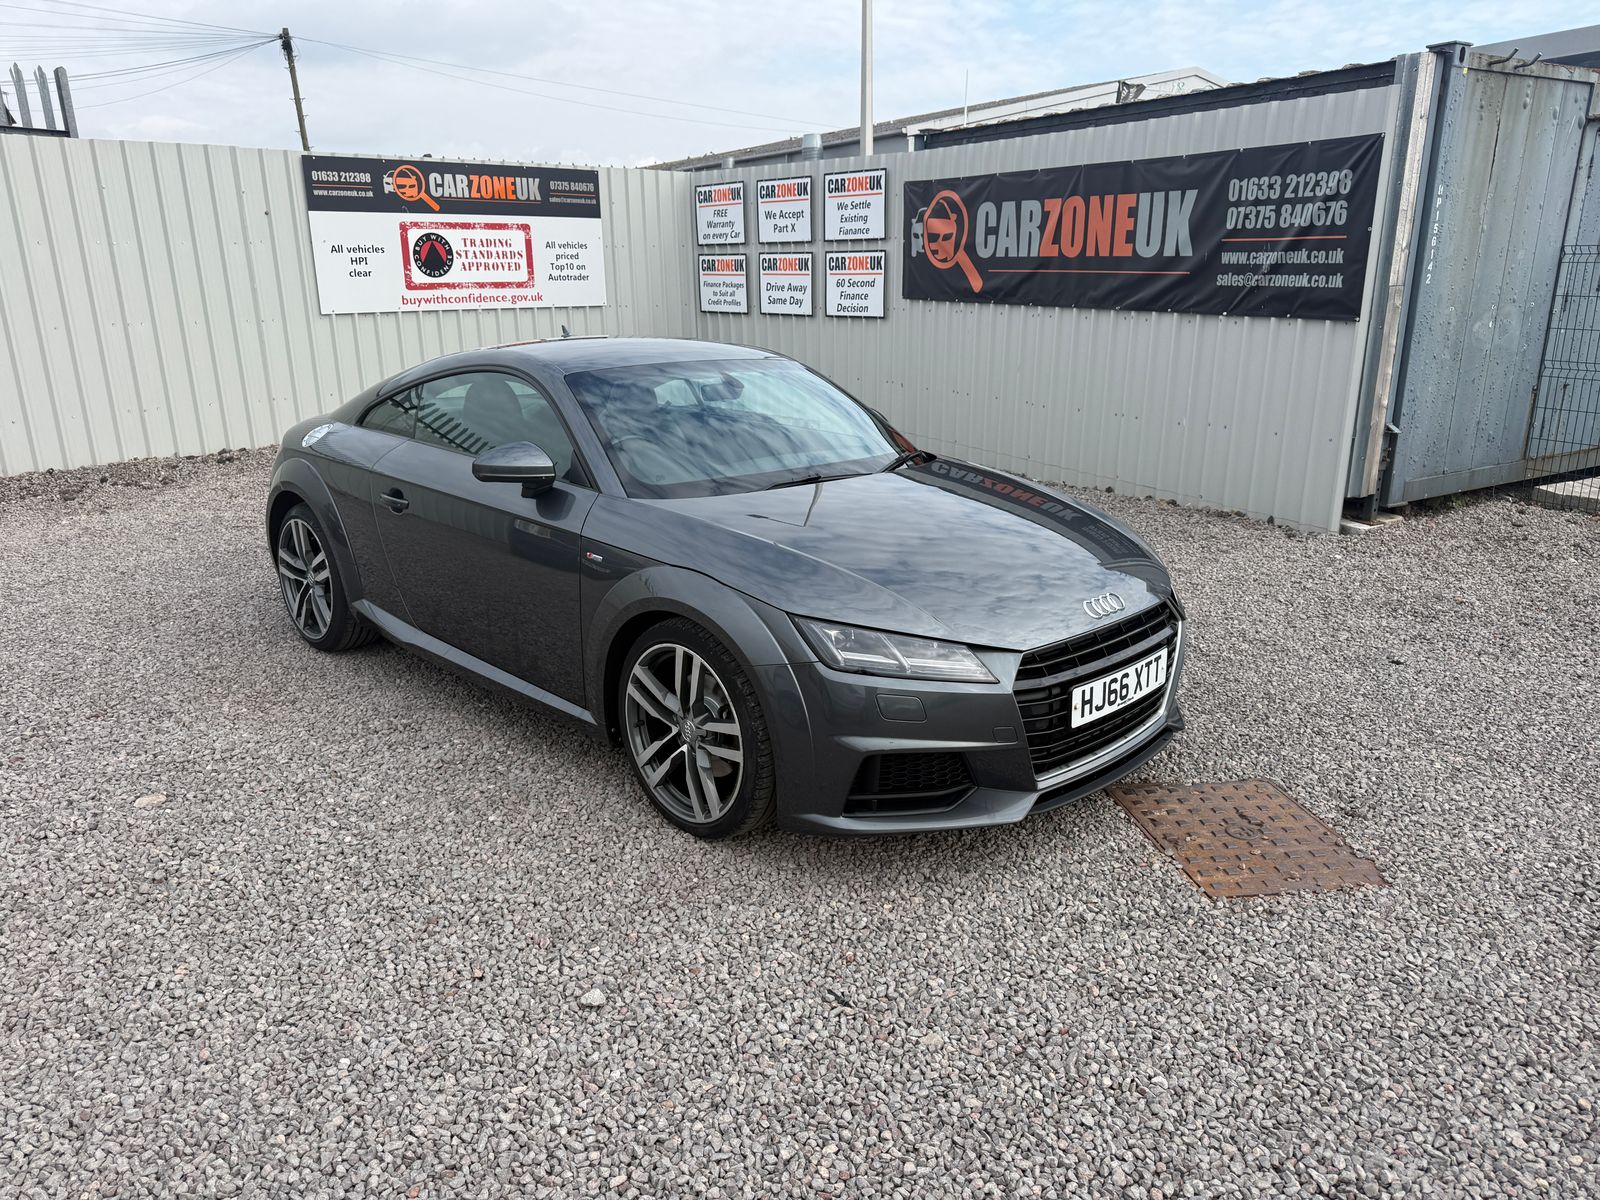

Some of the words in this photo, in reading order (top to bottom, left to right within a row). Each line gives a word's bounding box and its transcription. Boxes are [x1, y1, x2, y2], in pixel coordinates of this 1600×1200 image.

[312, 171, 339, 182] 01633
[340, 171, 371, 183] 212398
[428, 172, 541, 200] CARZONEUK
[550, 180, 570, 190] 07375
[570, 182, 594, 192] 840676
[828, 174, 882, 194] CARZONEUK
[1228, 175, 1282, 202] 01633
[1284, 169, 1353, 199] 212398
[313, 189, 373, 197] www.carzoneuk.co.uk
[698, 187, 742, 204] CARZONEUK
[760, 181, 809, 199] CARZONEUK
[837, 201, 849, 211] We
[850, 200, 871, 210] Settle
[713, 209, 728, 218] FREE
[764, 210, 777, 220] We
[778, 209, 804, 221] Accept
[840, 213, 868, 225] Existing
[1226, 205, 1276, 230] 07375
[1279, 200, 1348, 228] 840676
[706, 220, 735, 230] Warranty
[773, 223, 788, 233] Part
[790, 222, 796, 233] X
[974, 189, 1199, 259] CARZONEUK
[712, 232, 729, 241] every
[730, 230, 741, 239] Car
[838, 226, 870, 236] Fianance
[415, 236, 427, 250] BUY
[430, 234, 450, 250] WITH
[461, 238, 512, 248] TRADING
[545, 241, 556, 249] All
[557, 241, 588, 249] vehicles
[331, 244, 343, 253] All
[346, 244, 385, 254] vehicles
[455, 249, 523, 260] STANDARDS
[350, 256, 368, 265] HPI
[555, 252, 579, 261] priced
[1221, 248, 1345, 265] www.carzoneuk.co.uk
[414, 255, 452, 276] CONFIDENCE
[460, 261, 521, 271] APPROVED
[550, 262, 575, 273] Top10
[701, 258, 745, 272] CARZONEUK
[761, 257, 810, 272] CARZONEUK
[828, 255, 883, 271] CARZONEUK
[349, 268, 372, 277] clear
[548, 273, 589, 281] Autotrader
[703, 280, 721, 288] Finance
[722, 281, 745, 290] Packages
[836, 278, 846, 288] 60
[847, 277, 876, 288] Second
[1216, 272, 1344, 288] sales@carzoneuk.co.uk
[766, 282, 785, 292] Drive
[787, 283, 808, 295] Away
[401, 292, 544, 307] buywithconfidence.gov.uk
[840, 290, 869, 301] Finance
[708, 298, 722, 306] Credit
[723, 298, 742, 306] Profiles
[767, 295, 788, 305] Same
[789, 296, 804, 308] Day
[836, 303, 869, 313] Decision
[1080, 672, 1129, 718] HJ66
[1134, 655, 1162, 695] XTT
